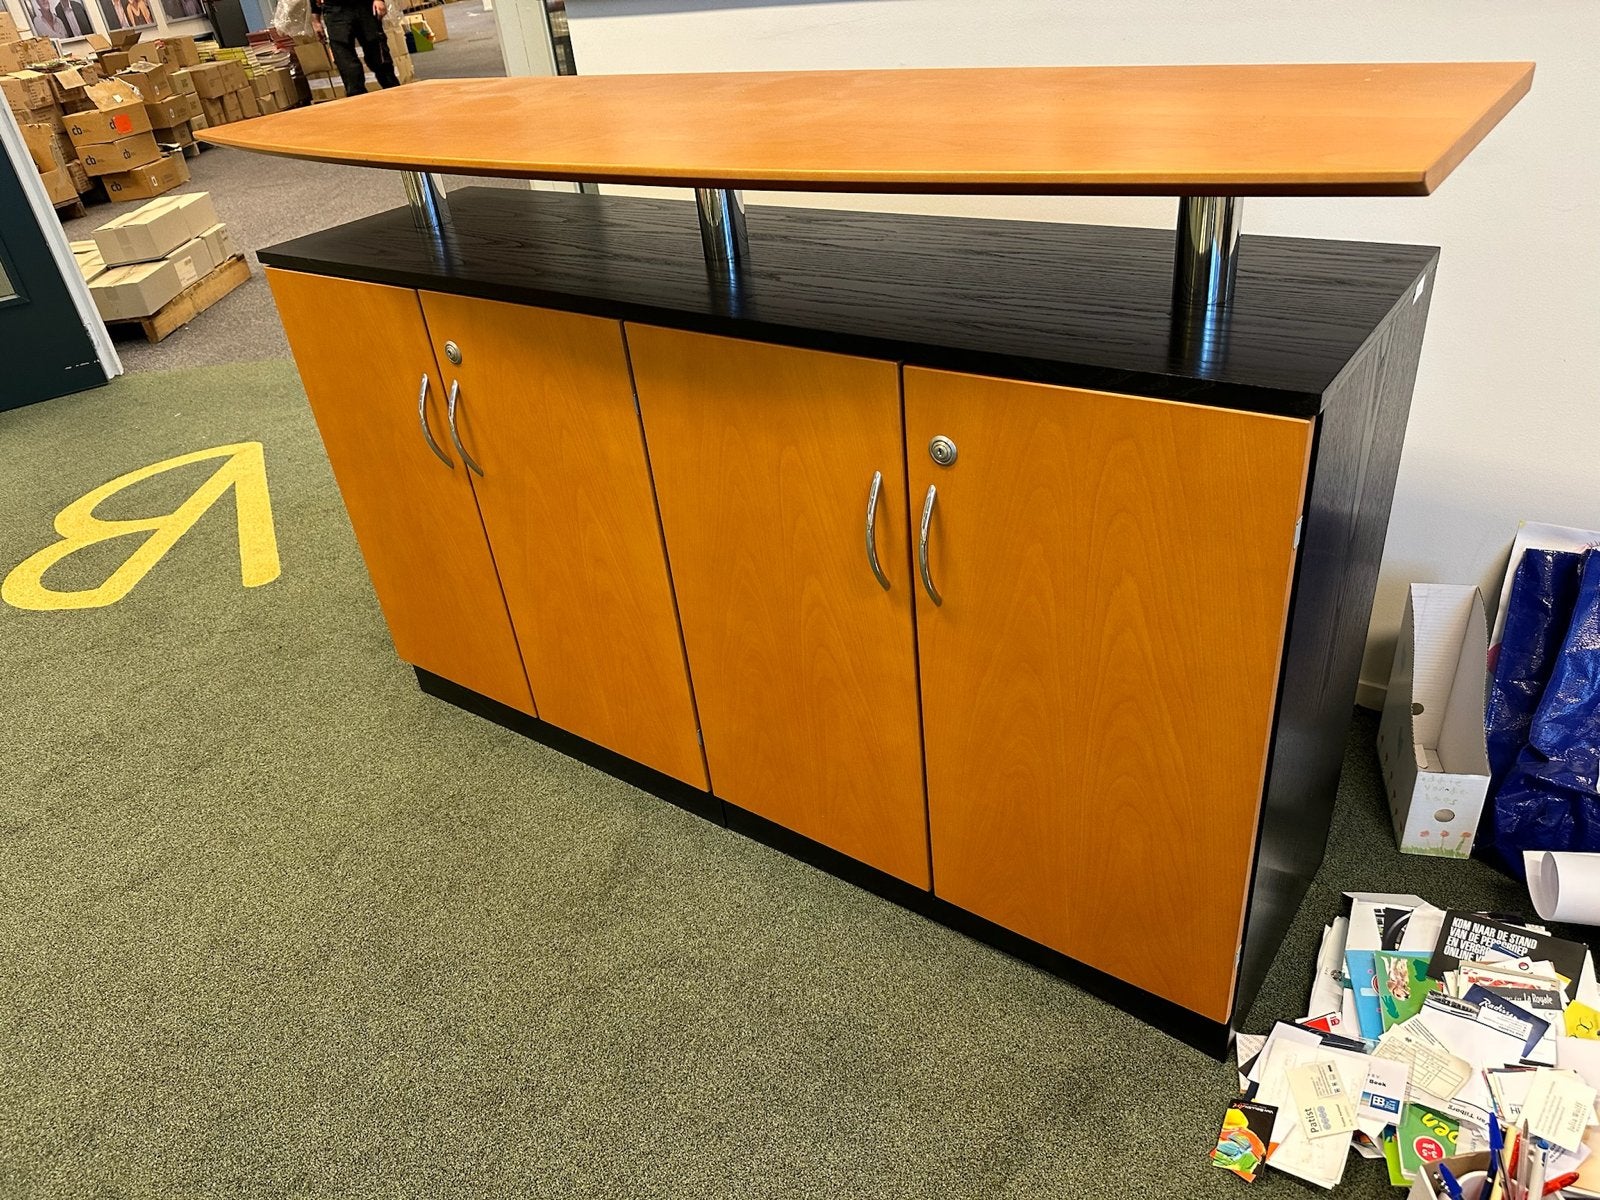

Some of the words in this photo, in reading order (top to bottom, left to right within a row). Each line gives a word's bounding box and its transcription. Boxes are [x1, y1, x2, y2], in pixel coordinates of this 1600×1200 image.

[72, 124, 83, 136] cb
[85, 154, 97, 166] cb
[123, 149, 131, 160] cb
[111, 181, 122, 192] cb
[1449, 926, 1468, 940] VAN
[1468, 932, 1481, 944] DE
[1452, 917, 1472, 931] KOM
[1472, 922, 1496, 937] NAAR
[1496, 930, 1510, 942] DE
[1509, 933, 1538, 950] STAND
[1446, 936, 1460, 947] EN
[1443, 945, 1475, 962] ONLINE
[1531, 993, 1554, 1006] Royale
[1304, 1107, 1319, 1134] Patist
[1421, 1148, 1438, 1159] 3-5
